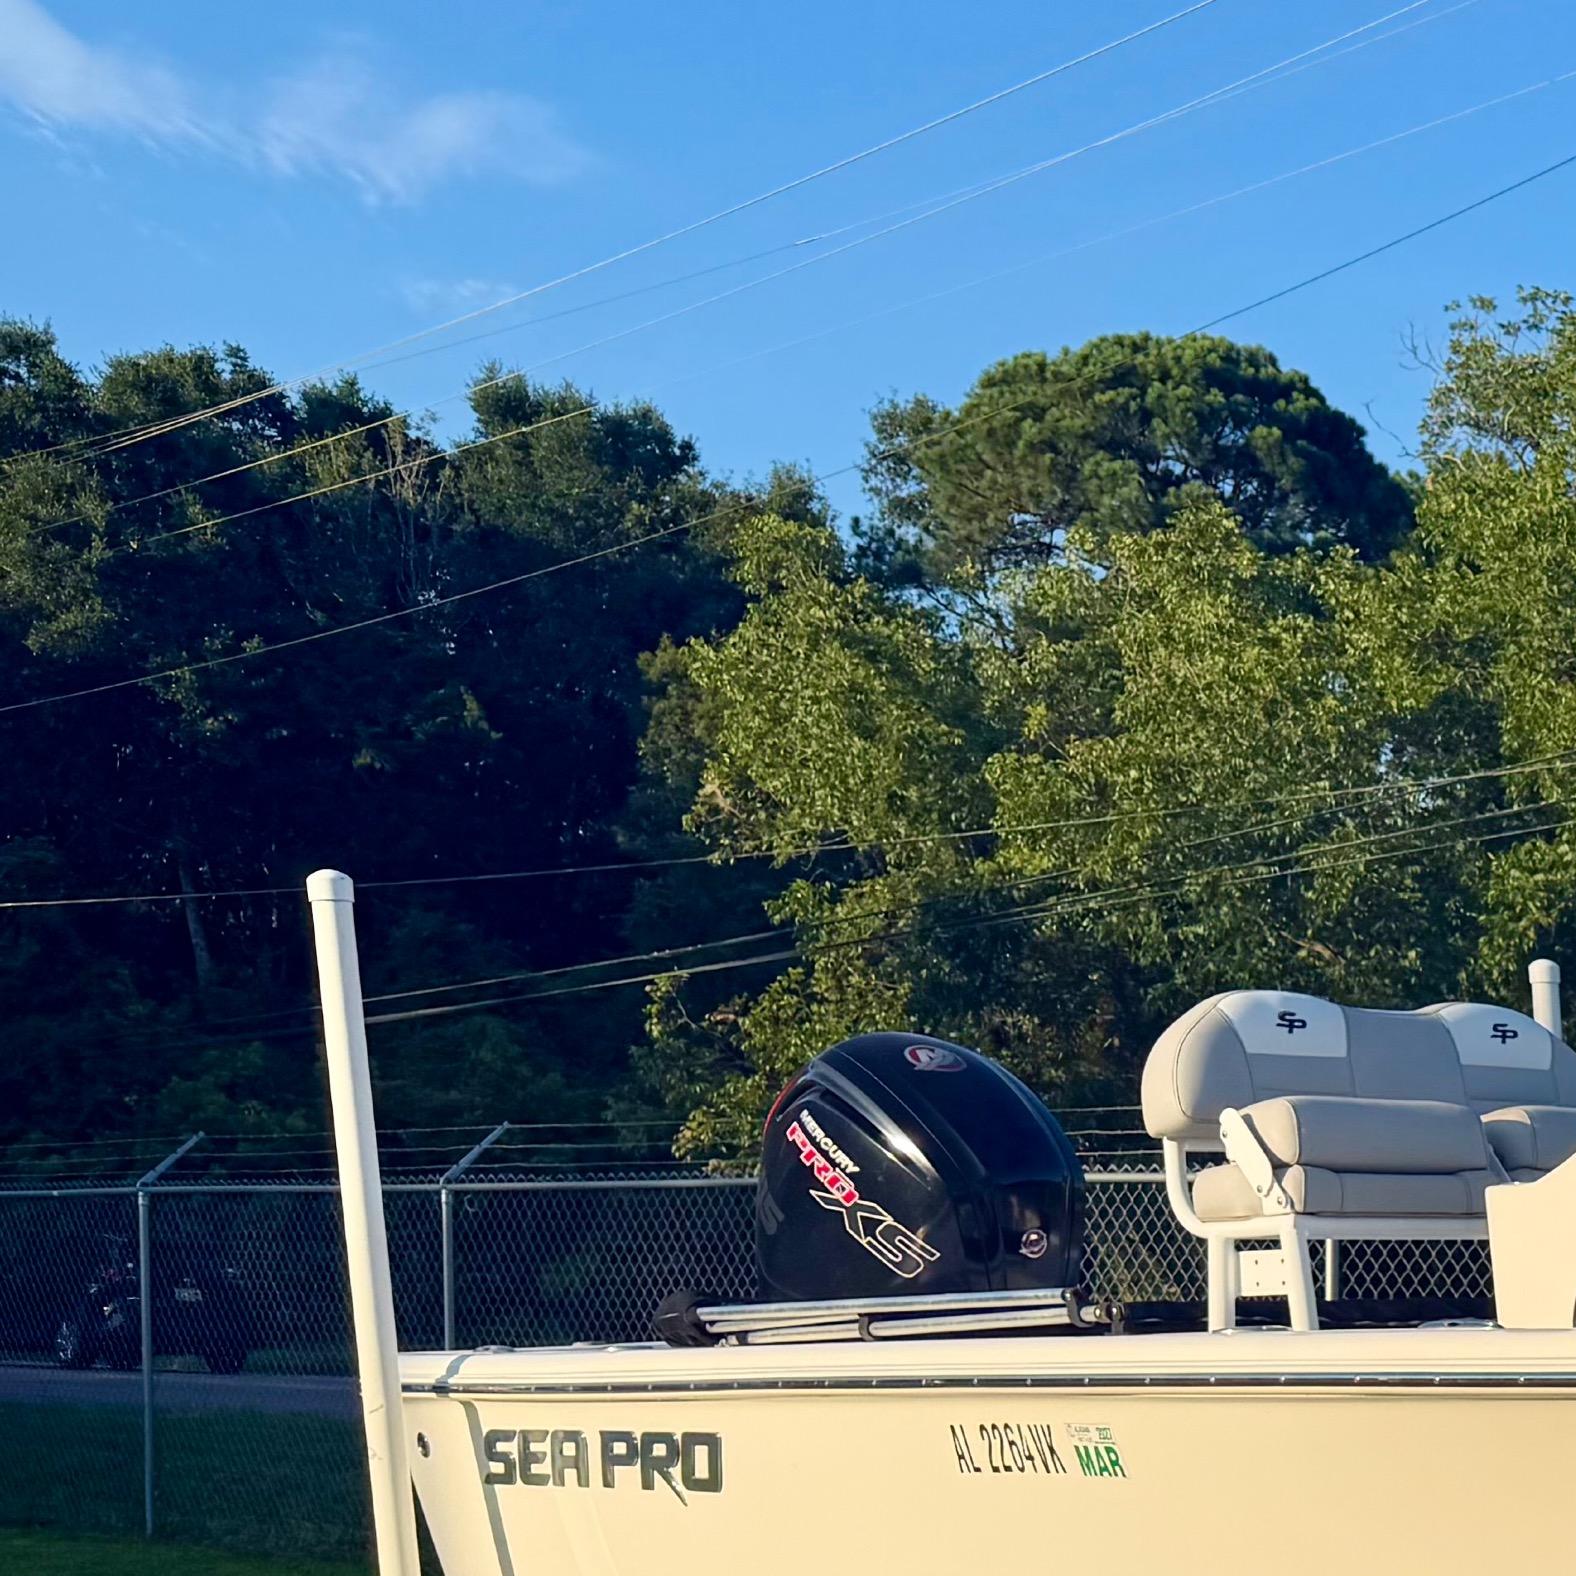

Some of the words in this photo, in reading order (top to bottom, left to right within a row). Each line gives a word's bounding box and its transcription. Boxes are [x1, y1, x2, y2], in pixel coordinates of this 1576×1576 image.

[800, 1109, 860, 1174] MERCURY
[809, 1189, 941, 1278] XS
[484, 1429, 590, 1488] SEA
[599, 1430, 723, 1507] PRO
[950, 1424, 982, 1474] AL
[1073, 1444, 1127, 1478] MAR
